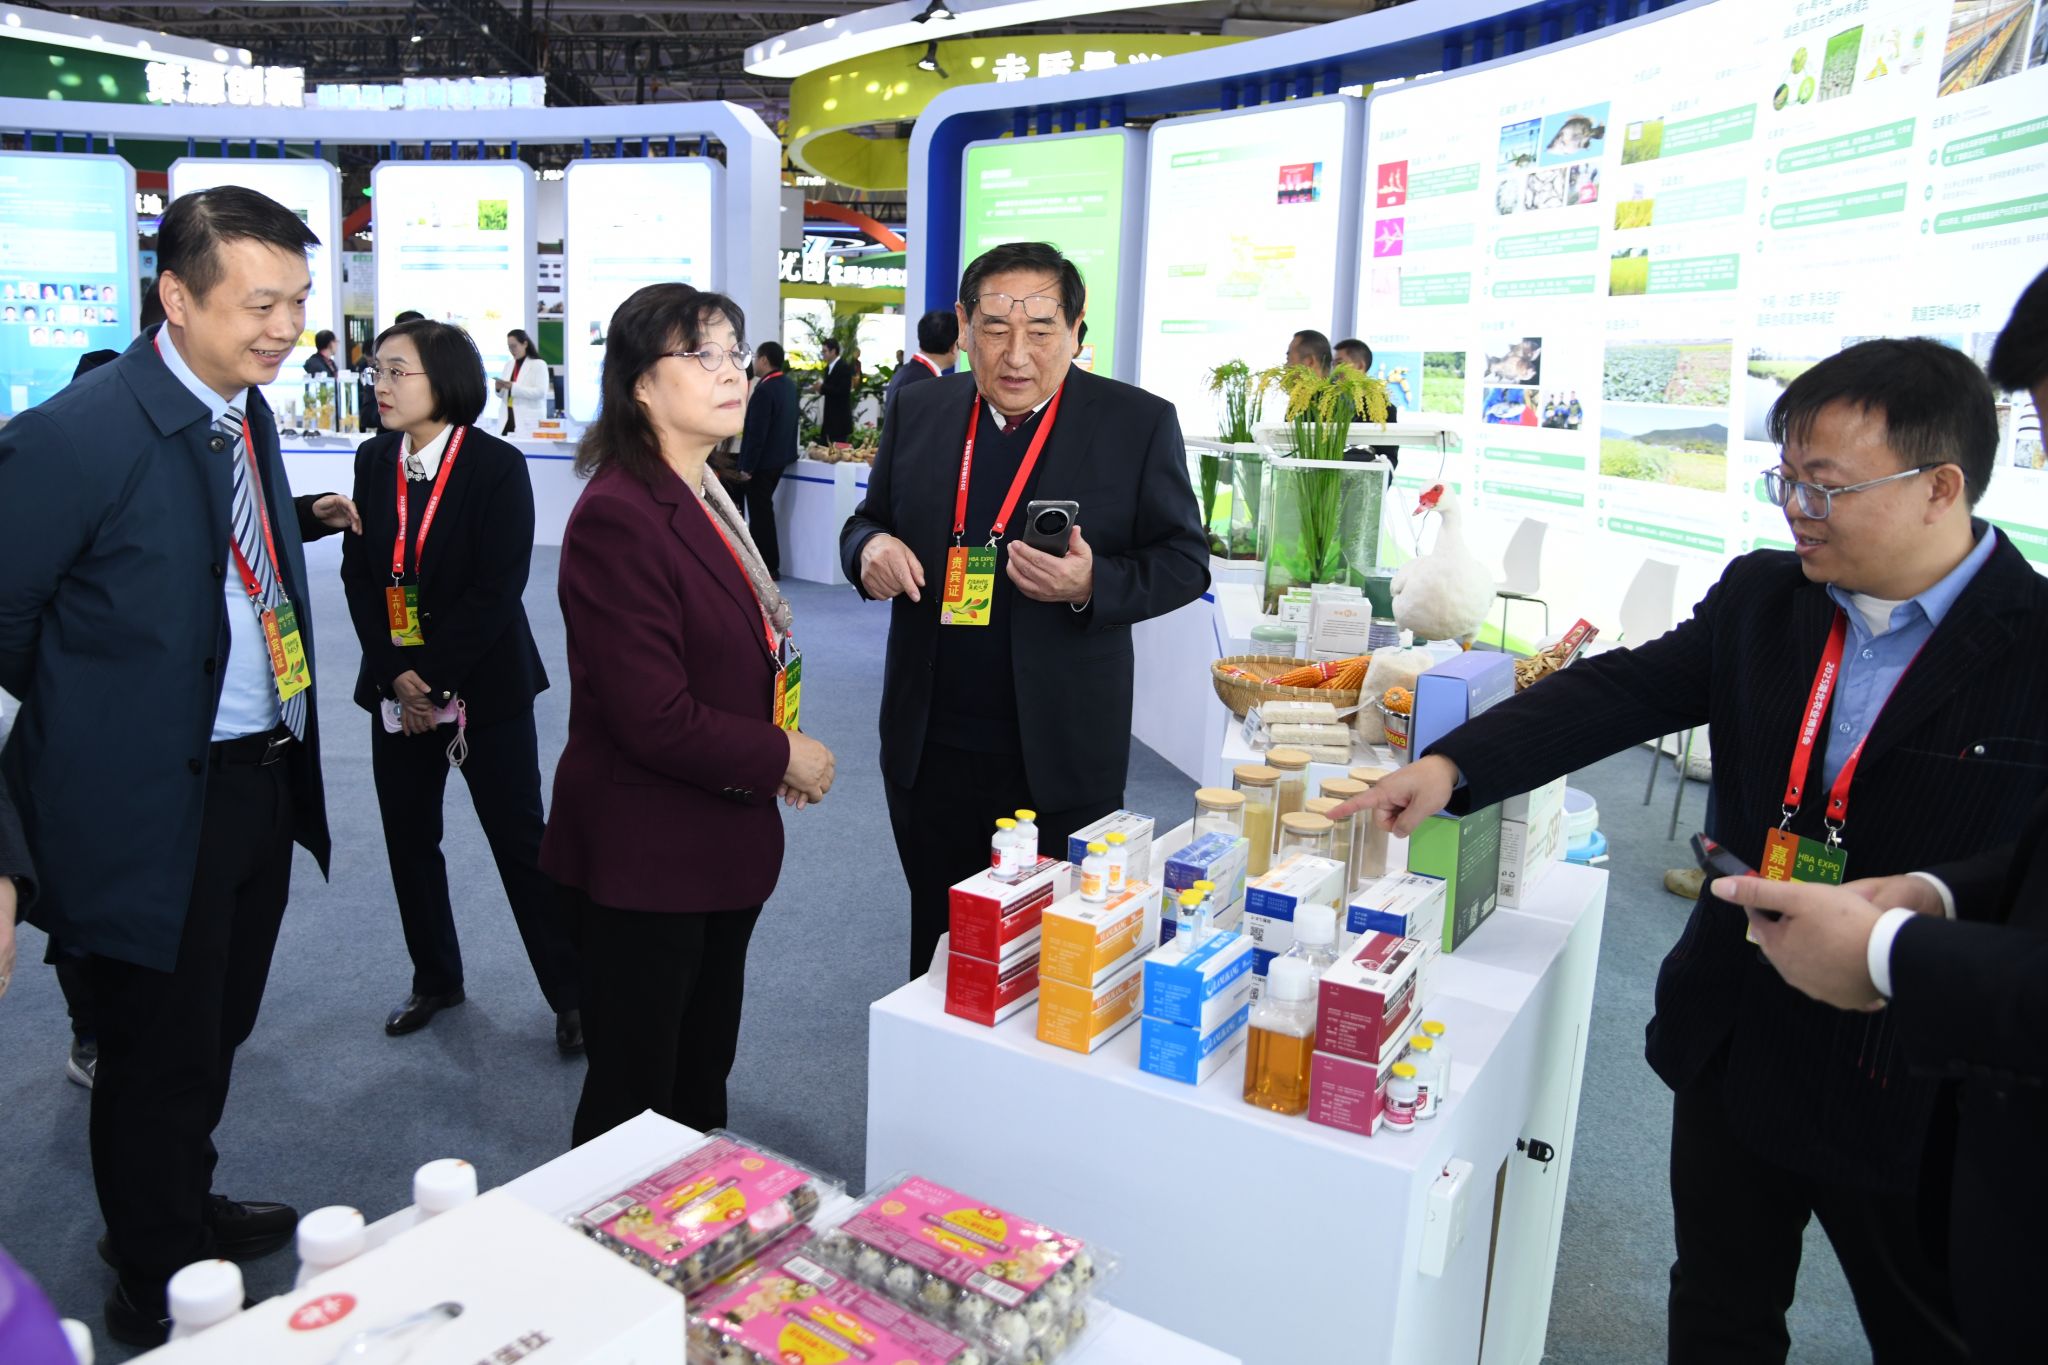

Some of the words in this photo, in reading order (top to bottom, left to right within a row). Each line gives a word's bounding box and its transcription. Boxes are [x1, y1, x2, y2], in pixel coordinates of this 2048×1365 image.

[948, 556, 963, 597] 贵宾证
[392, 594, 403, 625] 工作人员
[1802, 661, 1835, 746] 2025湖北农业博览会
[1798, 851, 1815, 863] HBA
[1817, 858, 1840, 872] EXPO
